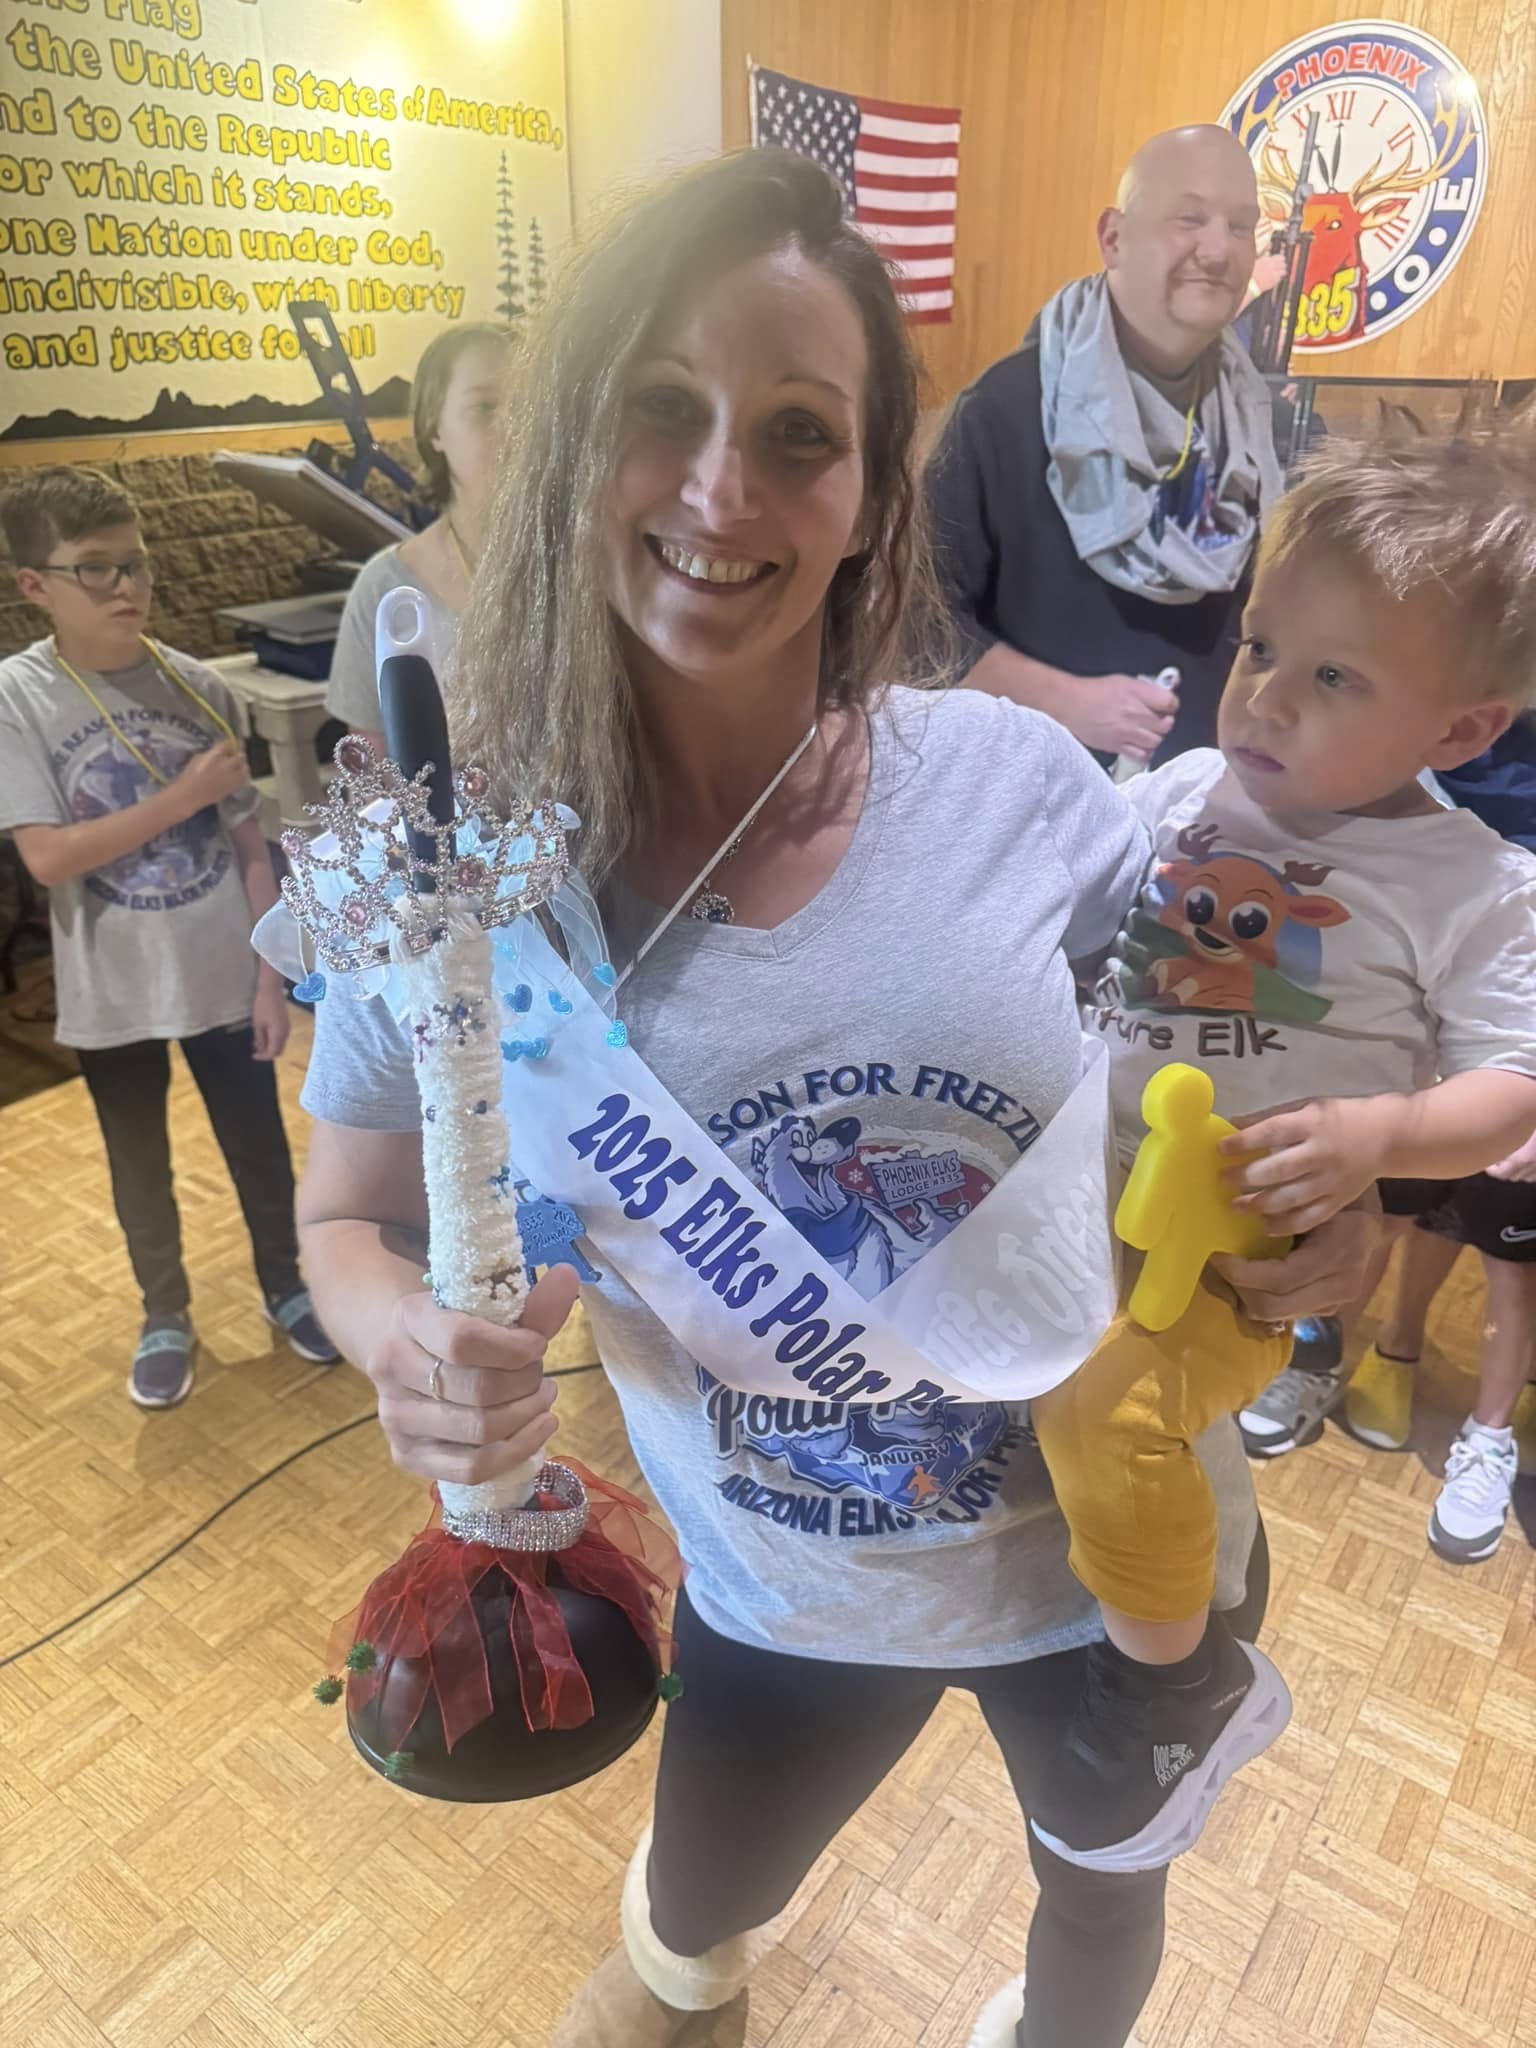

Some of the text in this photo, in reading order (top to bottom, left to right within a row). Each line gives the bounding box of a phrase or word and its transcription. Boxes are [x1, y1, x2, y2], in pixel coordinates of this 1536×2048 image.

[6, 18, 563, 151] the United States of America,
[1274, 42, 1430, 100] PHOENIX
[64, 96, 121, 142] to
[129, 102, 208, 151] the
[218, 113, 392, 170] Republic
[0, 154, 392, 219] or which it stands,
[84, 213, 232, 258] Nation
[239, 228, 358, 265] under
[366, 229, 445, 271] God,
[0, 268, 466, 319] indivisible, with liberty
[3, 323, 376, 372] and justice fo ll
[1197, 1015, 1289, 1058] Elk
[802, 1062, 901, 1105] FOR
[882, 1156, 958, 1188] PHOENIX ELKS
[891, 1173, 961, 1199] LODGE #335
[567, 1092, 892, 1401] 2025 Elks Polar
[859, 1438, 950, 1468] JANUARY
[714, 1473, 831, 1536] ARIZONA
[839, 1497, 917, 1537] ELKS
